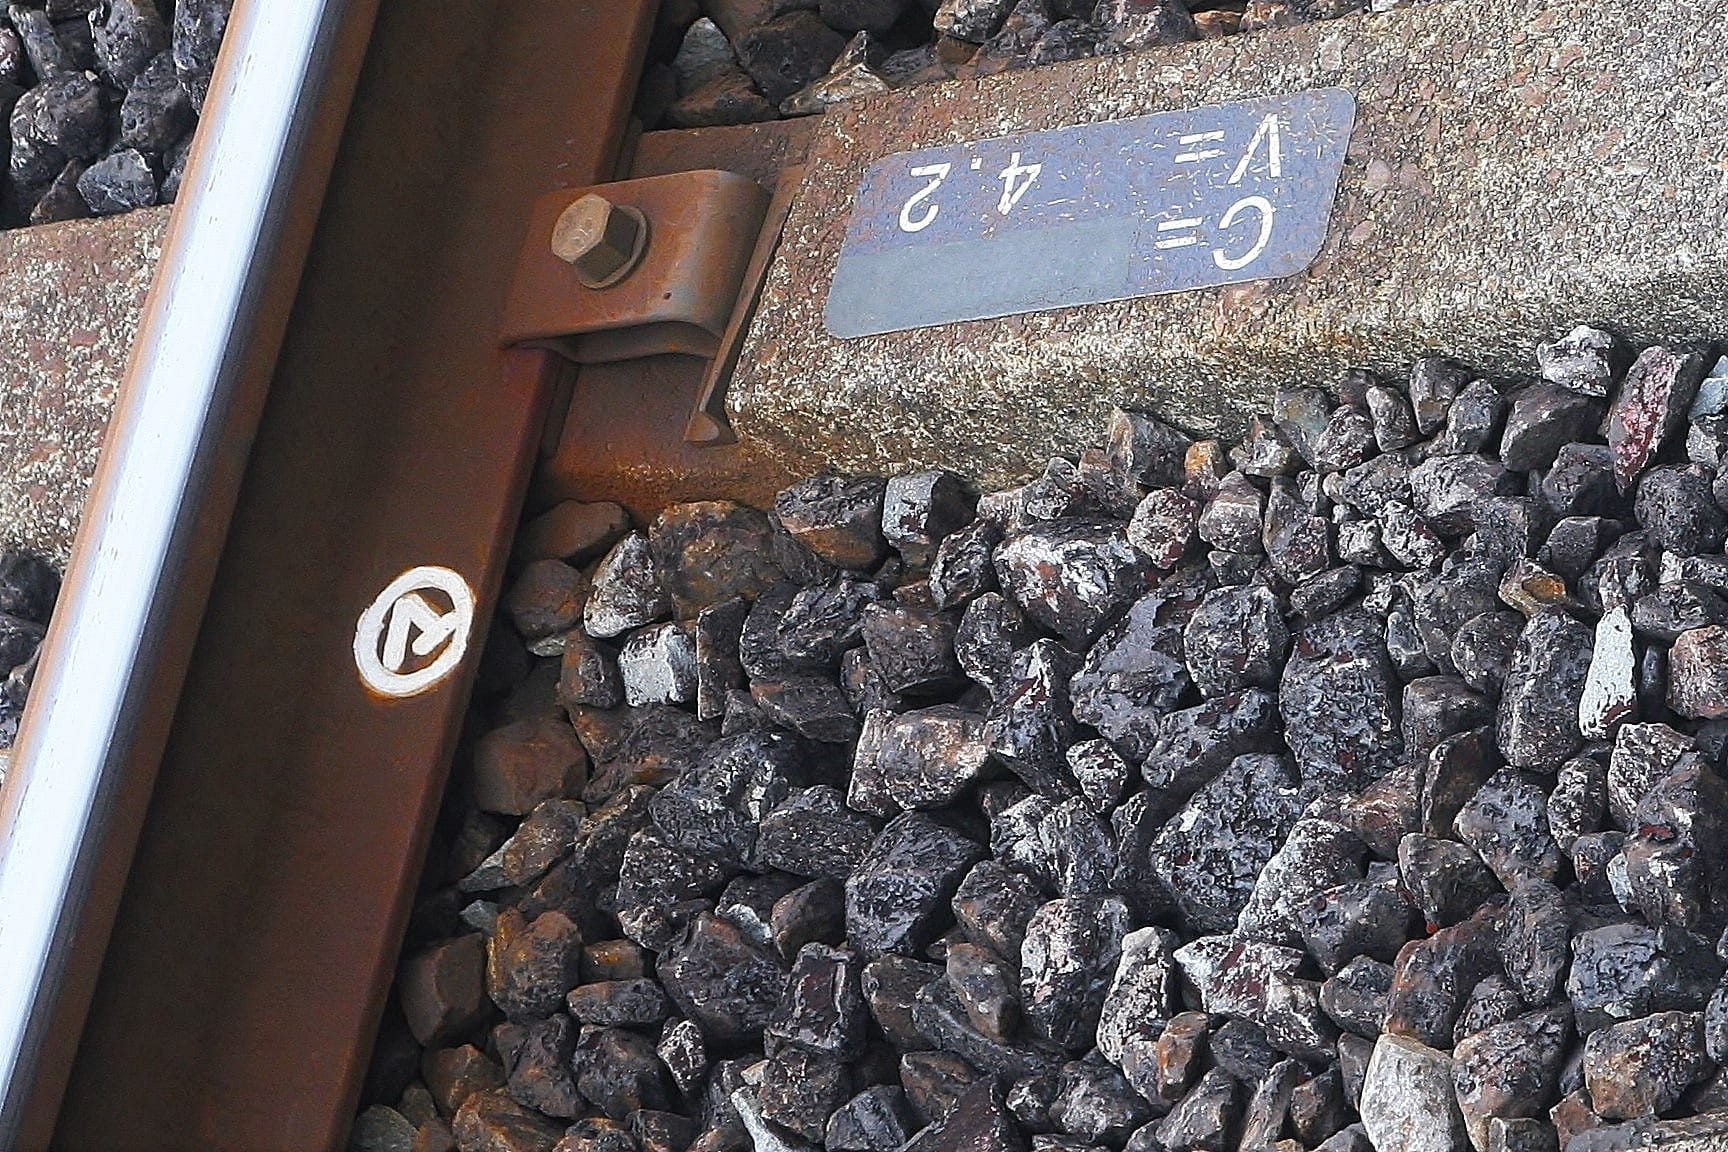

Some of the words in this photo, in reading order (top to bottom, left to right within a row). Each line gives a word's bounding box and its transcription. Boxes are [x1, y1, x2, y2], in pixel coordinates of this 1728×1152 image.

[1175, 114, 1284, 184] V=
[899, 152, 1042, 232] 4.2
[1156, 196, 1273, 270] C=
